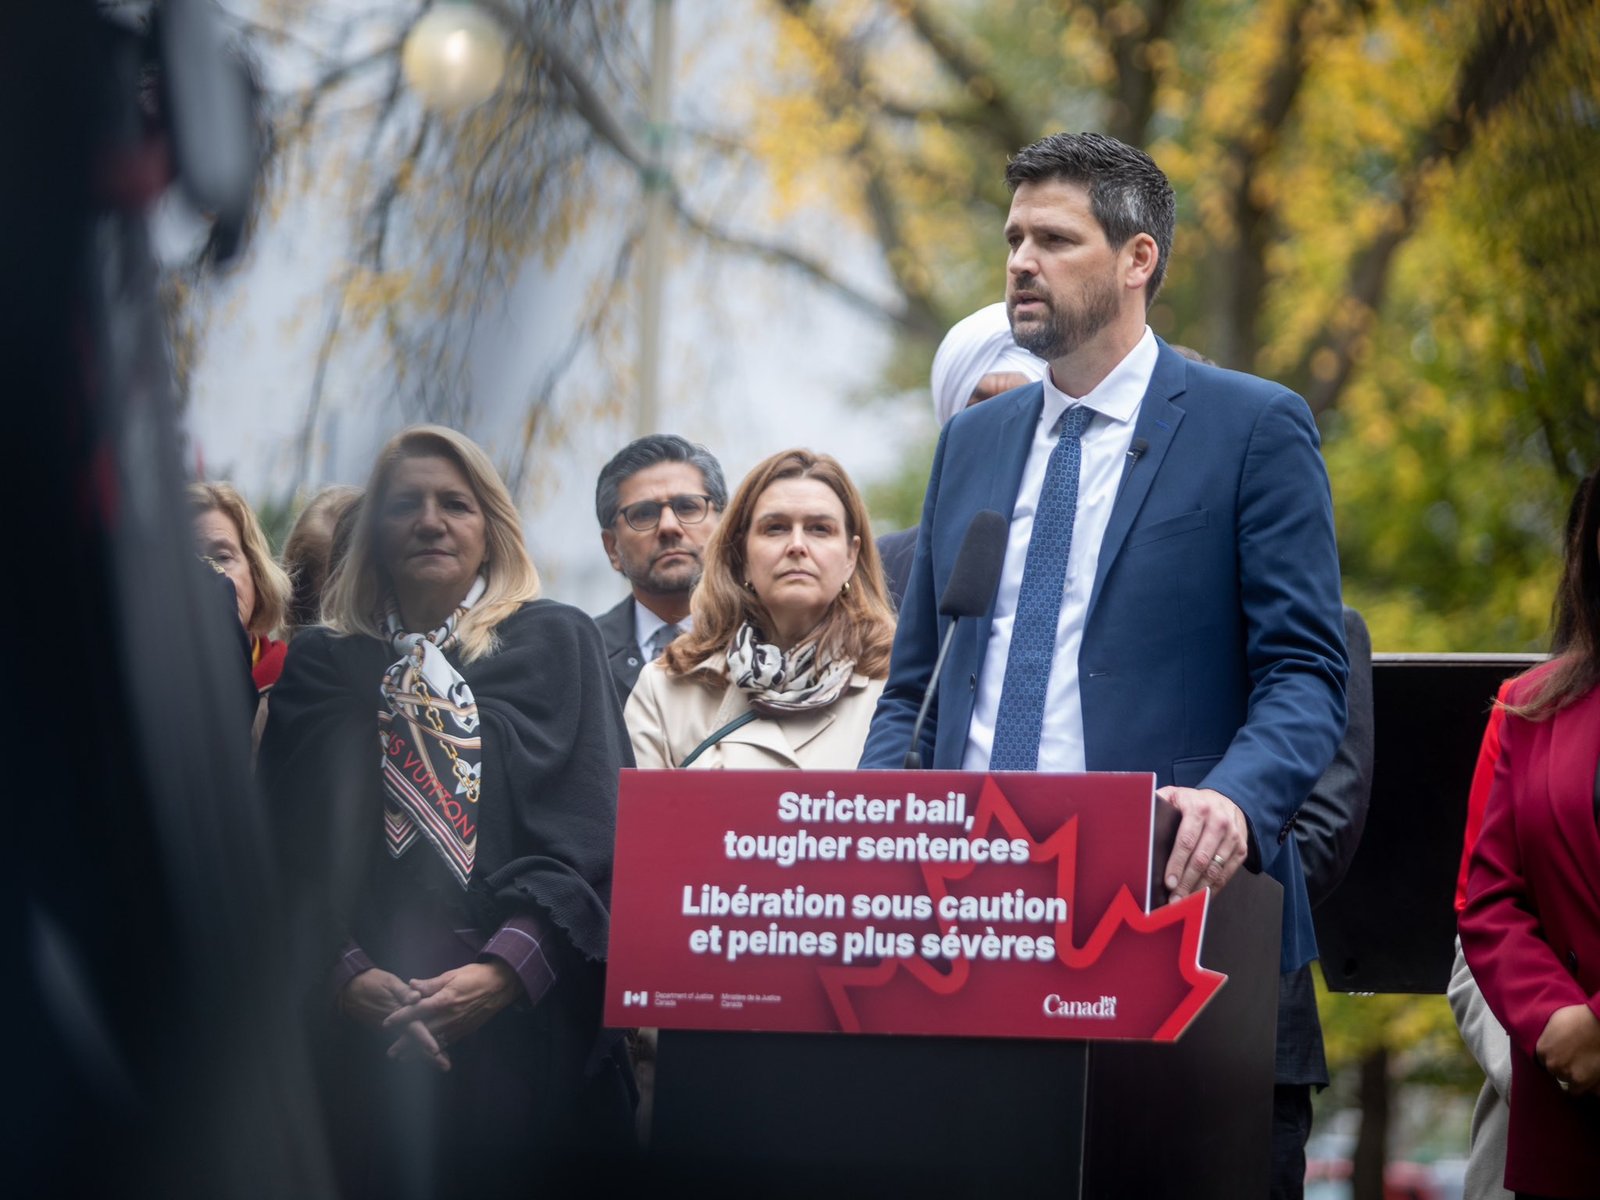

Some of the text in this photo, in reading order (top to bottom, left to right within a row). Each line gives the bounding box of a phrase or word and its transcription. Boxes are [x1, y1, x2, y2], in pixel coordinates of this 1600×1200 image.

[403, 751, 476, 838] VUITTON
[777, 791, 975, 831] Stricter bail,
[724, 830, 1030, 867] tougher sentences
[682, 883, 1067, 922] Libération sous caution
[689, 924, 1056, 963] et peines plus sévères
[1043, 993, 1116, 1017] Canada
